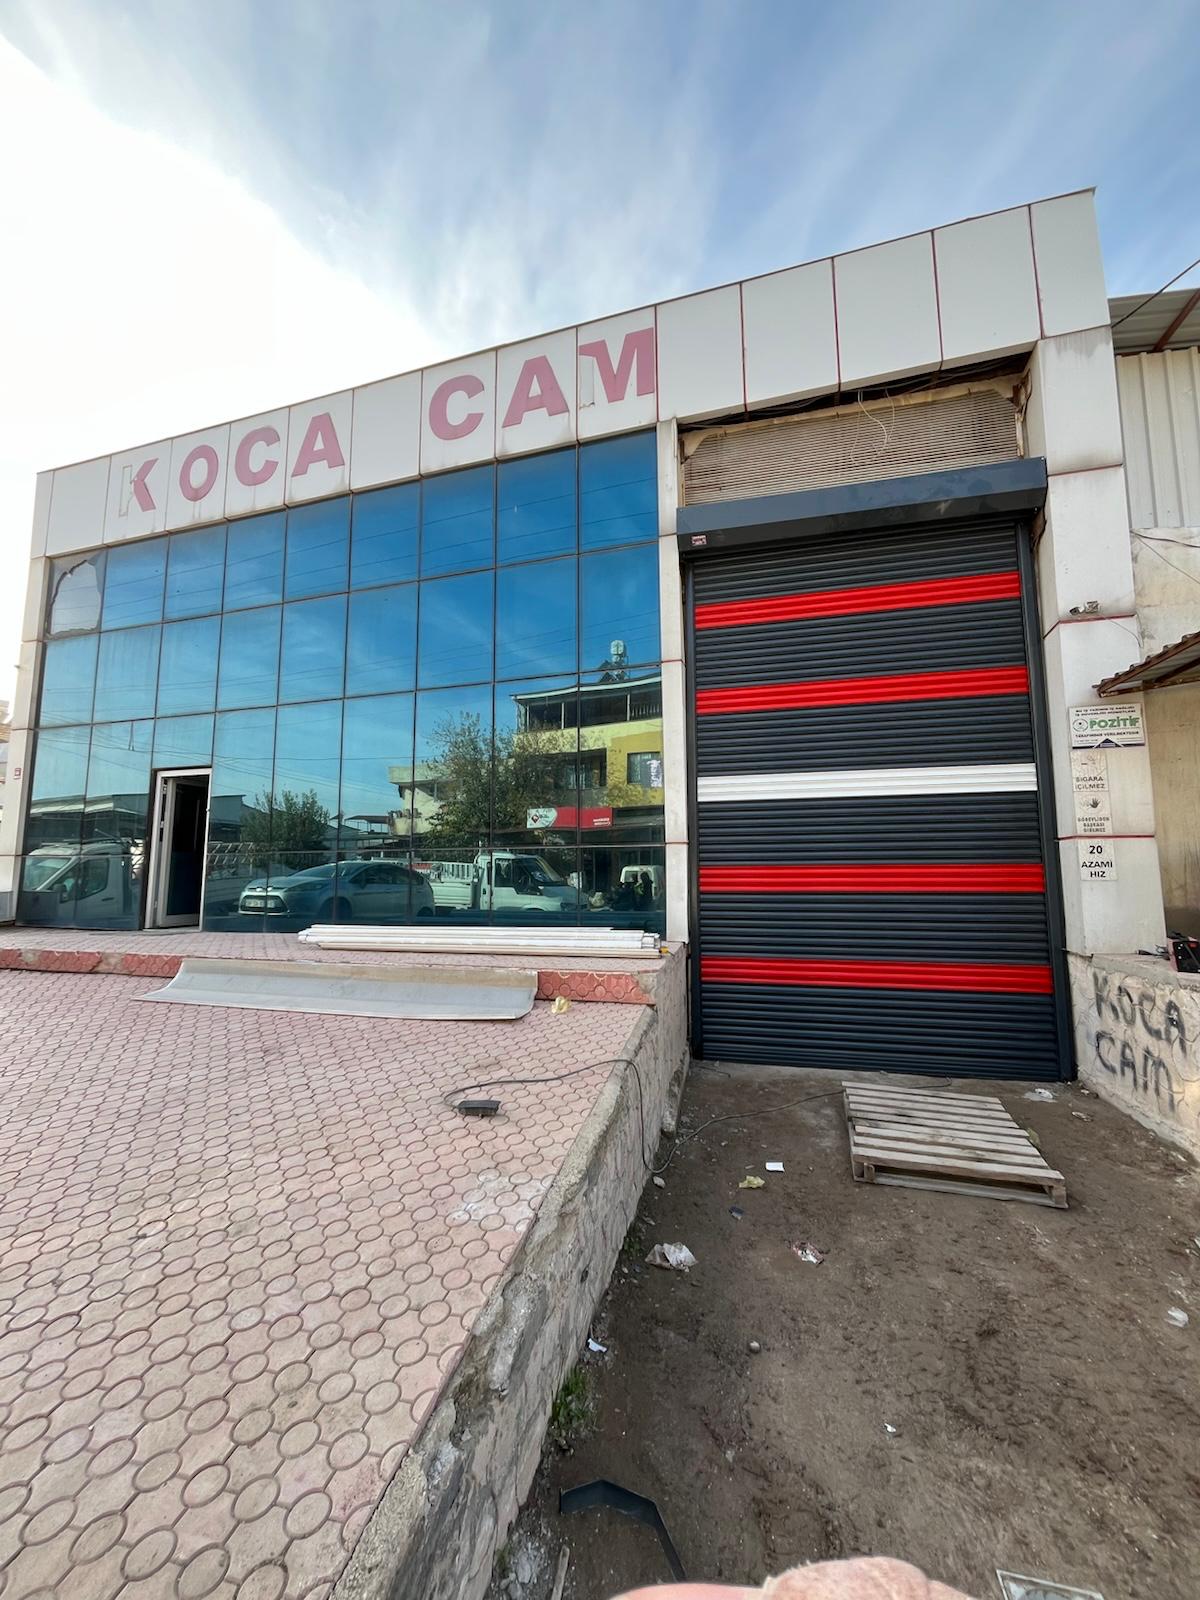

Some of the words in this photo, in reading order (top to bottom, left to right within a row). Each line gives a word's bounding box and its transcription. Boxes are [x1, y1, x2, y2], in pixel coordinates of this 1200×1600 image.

[119, 412, 345, 517] KOCA
[429, 327, 655, 440] CAM
[1081, 860, 1113, 868] AZAMİ
[1089, 845, 1103, 854] 20
[1093, 970, 1188, 1059] KOCA
